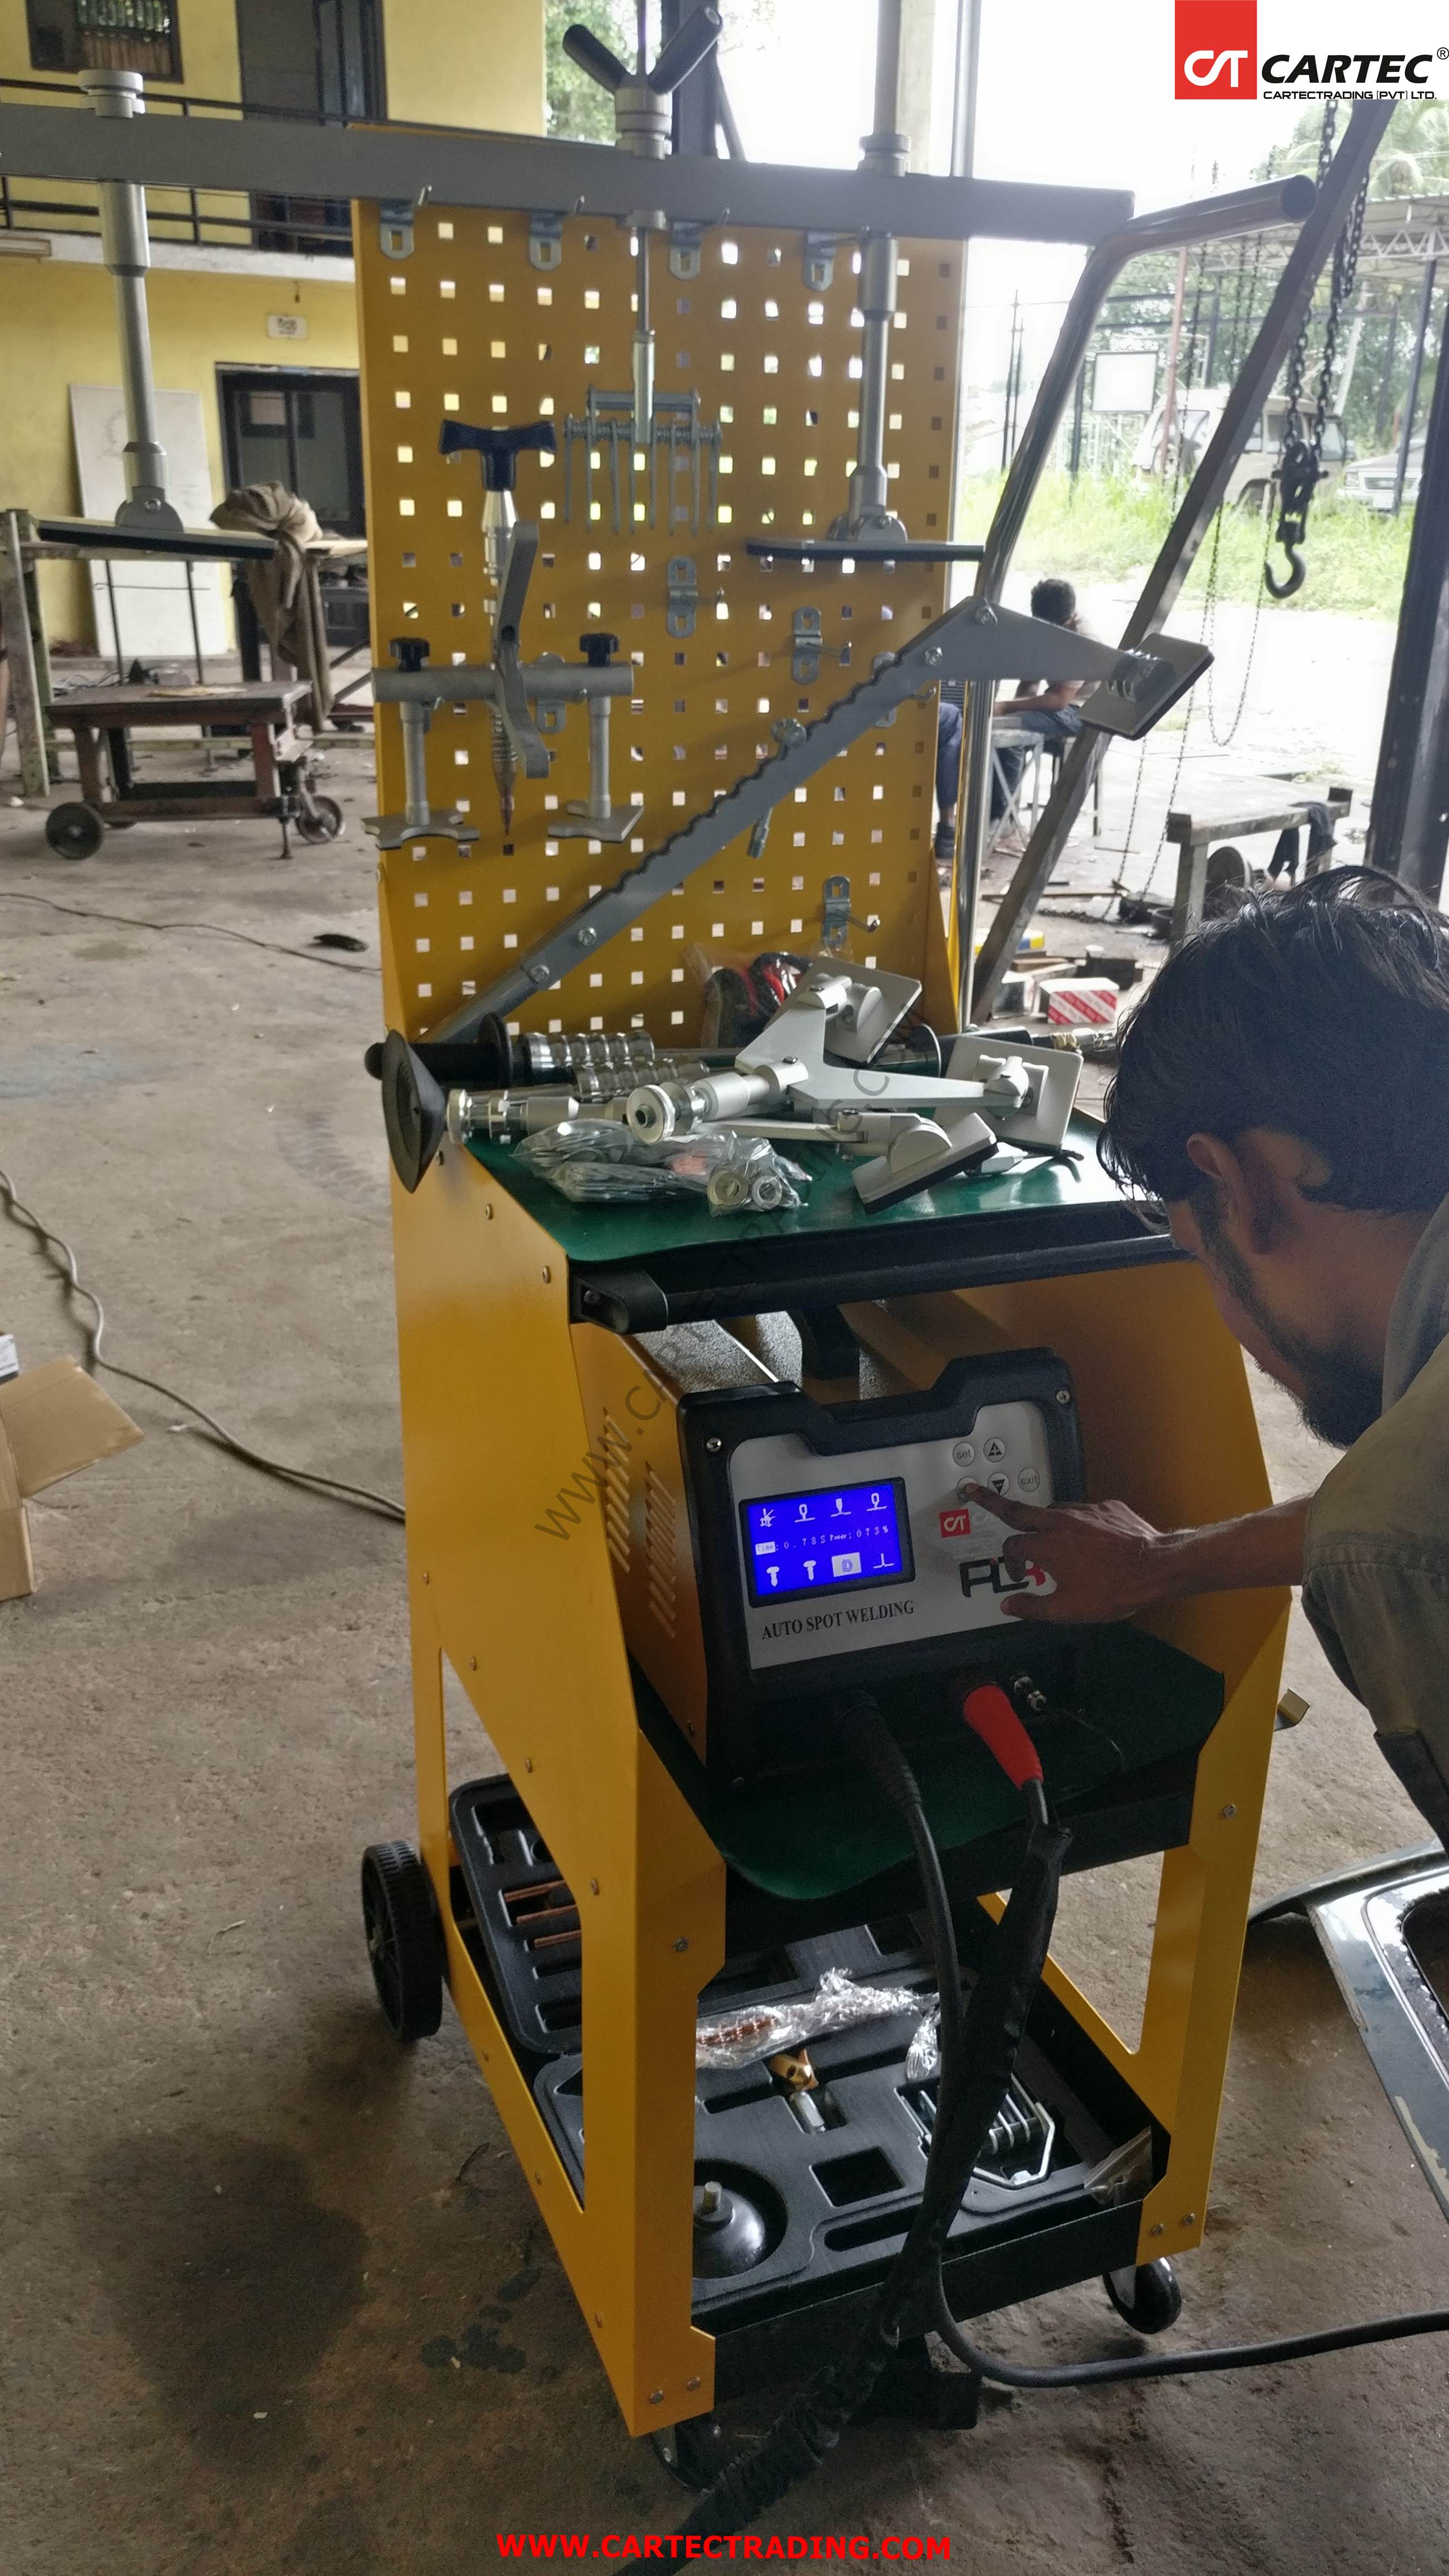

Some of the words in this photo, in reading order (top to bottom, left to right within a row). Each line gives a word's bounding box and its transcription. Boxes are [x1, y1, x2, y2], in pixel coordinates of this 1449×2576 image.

[956, 1450, 972, 1459] set
[1020, 1473, 1038, 1486] exit
[762, 1619, 803, 1639] AUTO
[806, 1612, 842, 1632] SPOT
[846, 1599, 914, 1623] WELDING
